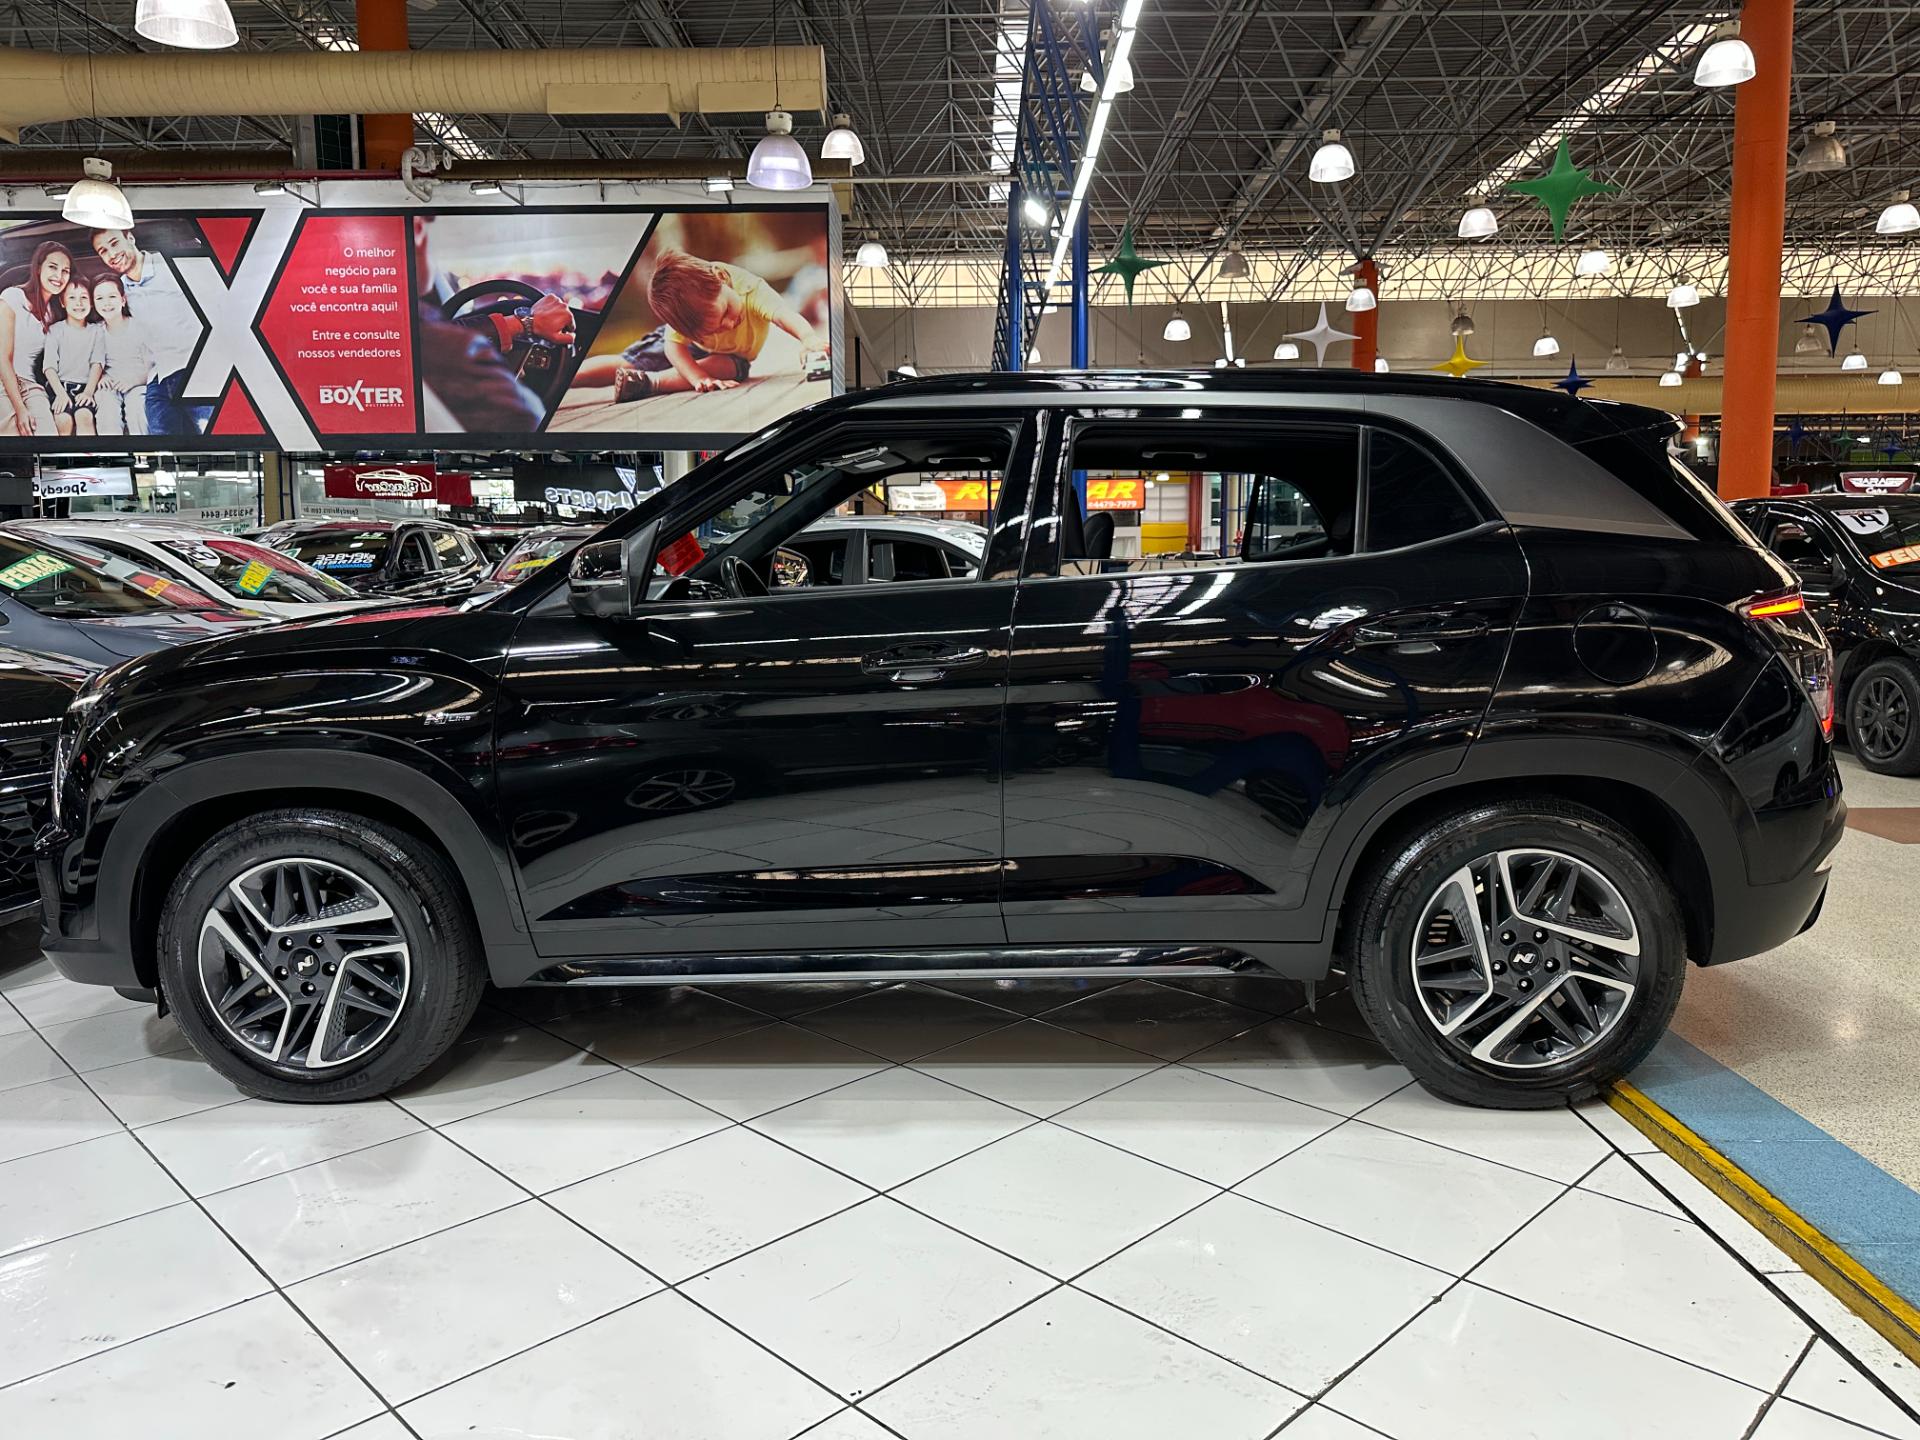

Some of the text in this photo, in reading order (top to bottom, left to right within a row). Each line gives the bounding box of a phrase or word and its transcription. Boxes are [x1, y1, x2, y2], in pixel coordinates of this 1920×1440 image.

[344, 247, 396, 258] O melhor
[325, 265, 397, 278] negócio para
[301, 283, 398, 294] você e sua família
[290, 301, 398, 314] você encontra aqui!
[312, 329, 400, 341] Entre e consulte
[297, 347, 401, 358] nossos vendedores
[320, 379, 404, 412] BOXTER
[1087, 481, 1136, 499] AR
